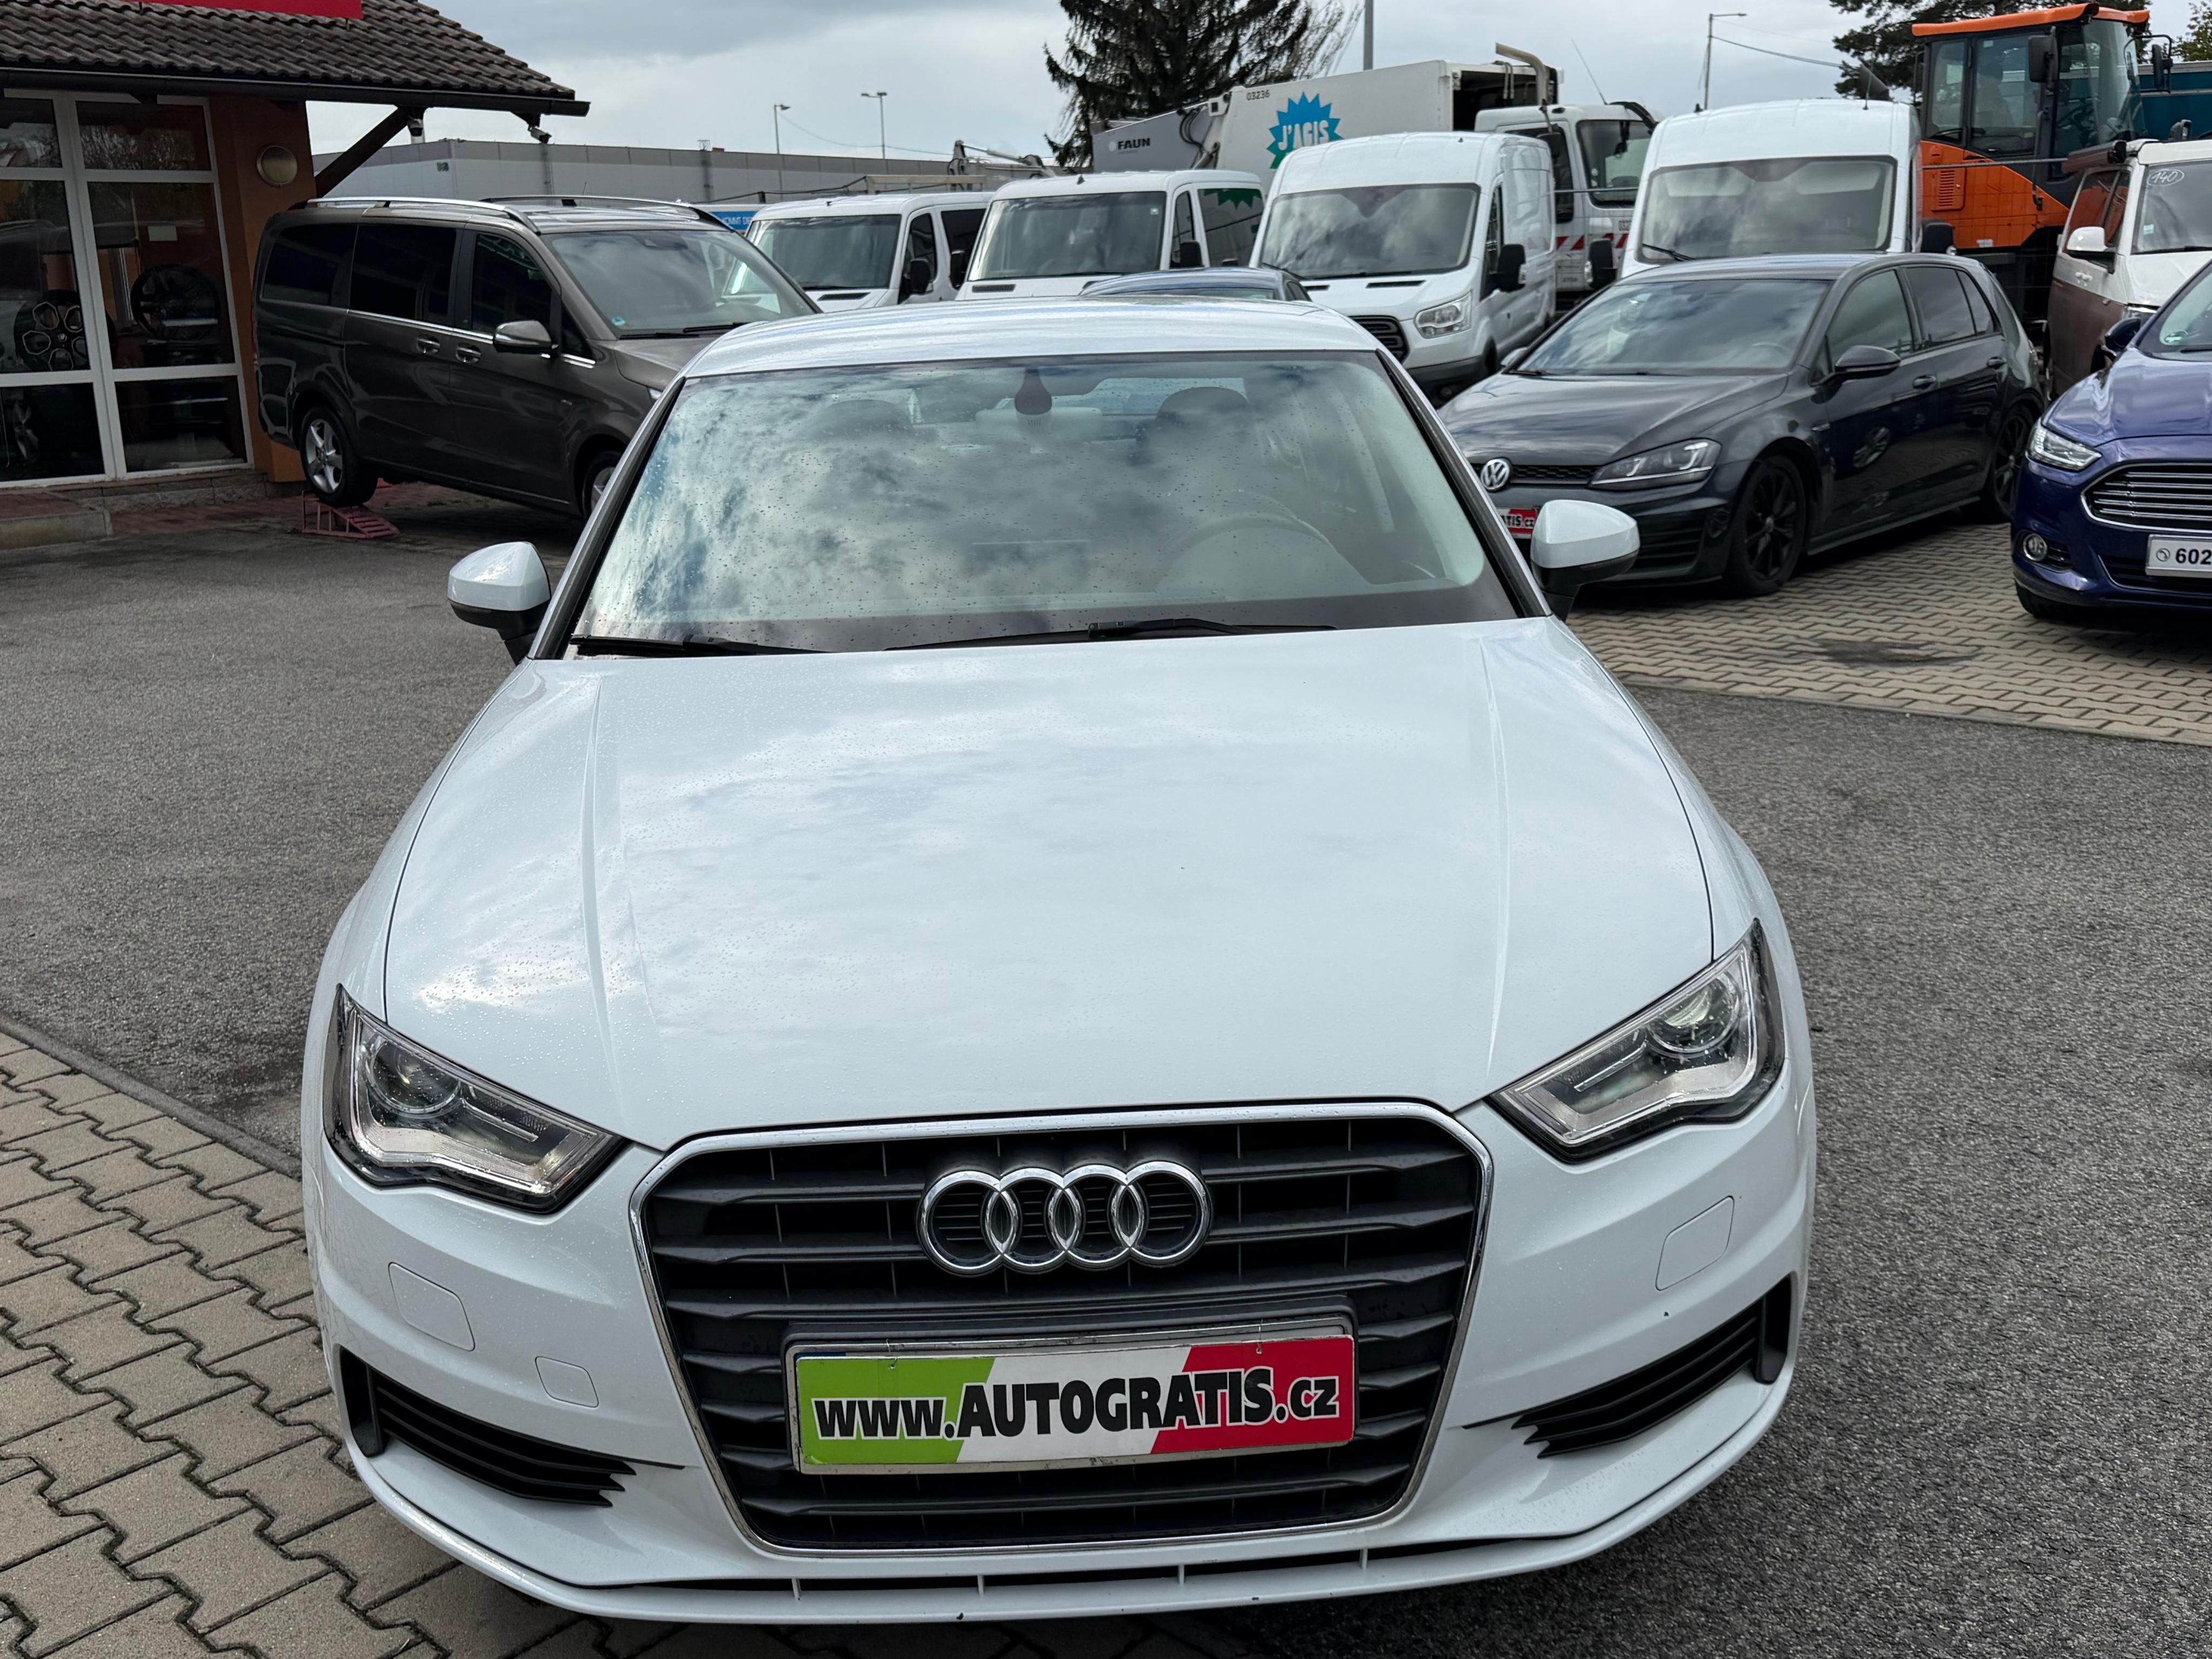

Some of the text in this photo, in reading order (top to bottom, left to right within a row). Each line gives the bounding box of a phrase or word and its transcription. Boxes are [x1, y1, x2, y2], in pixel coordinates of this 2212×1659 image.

[1246, 89, 1271, 101] 03236
[1278, 119, 1330, 151] J'AGIS
[1117, 137, 1150, 150] FAUN
[2152, 171, 2178, 183] 140
[813, 1367, 1338, 1439] www.AUTOGRATIS.cz
